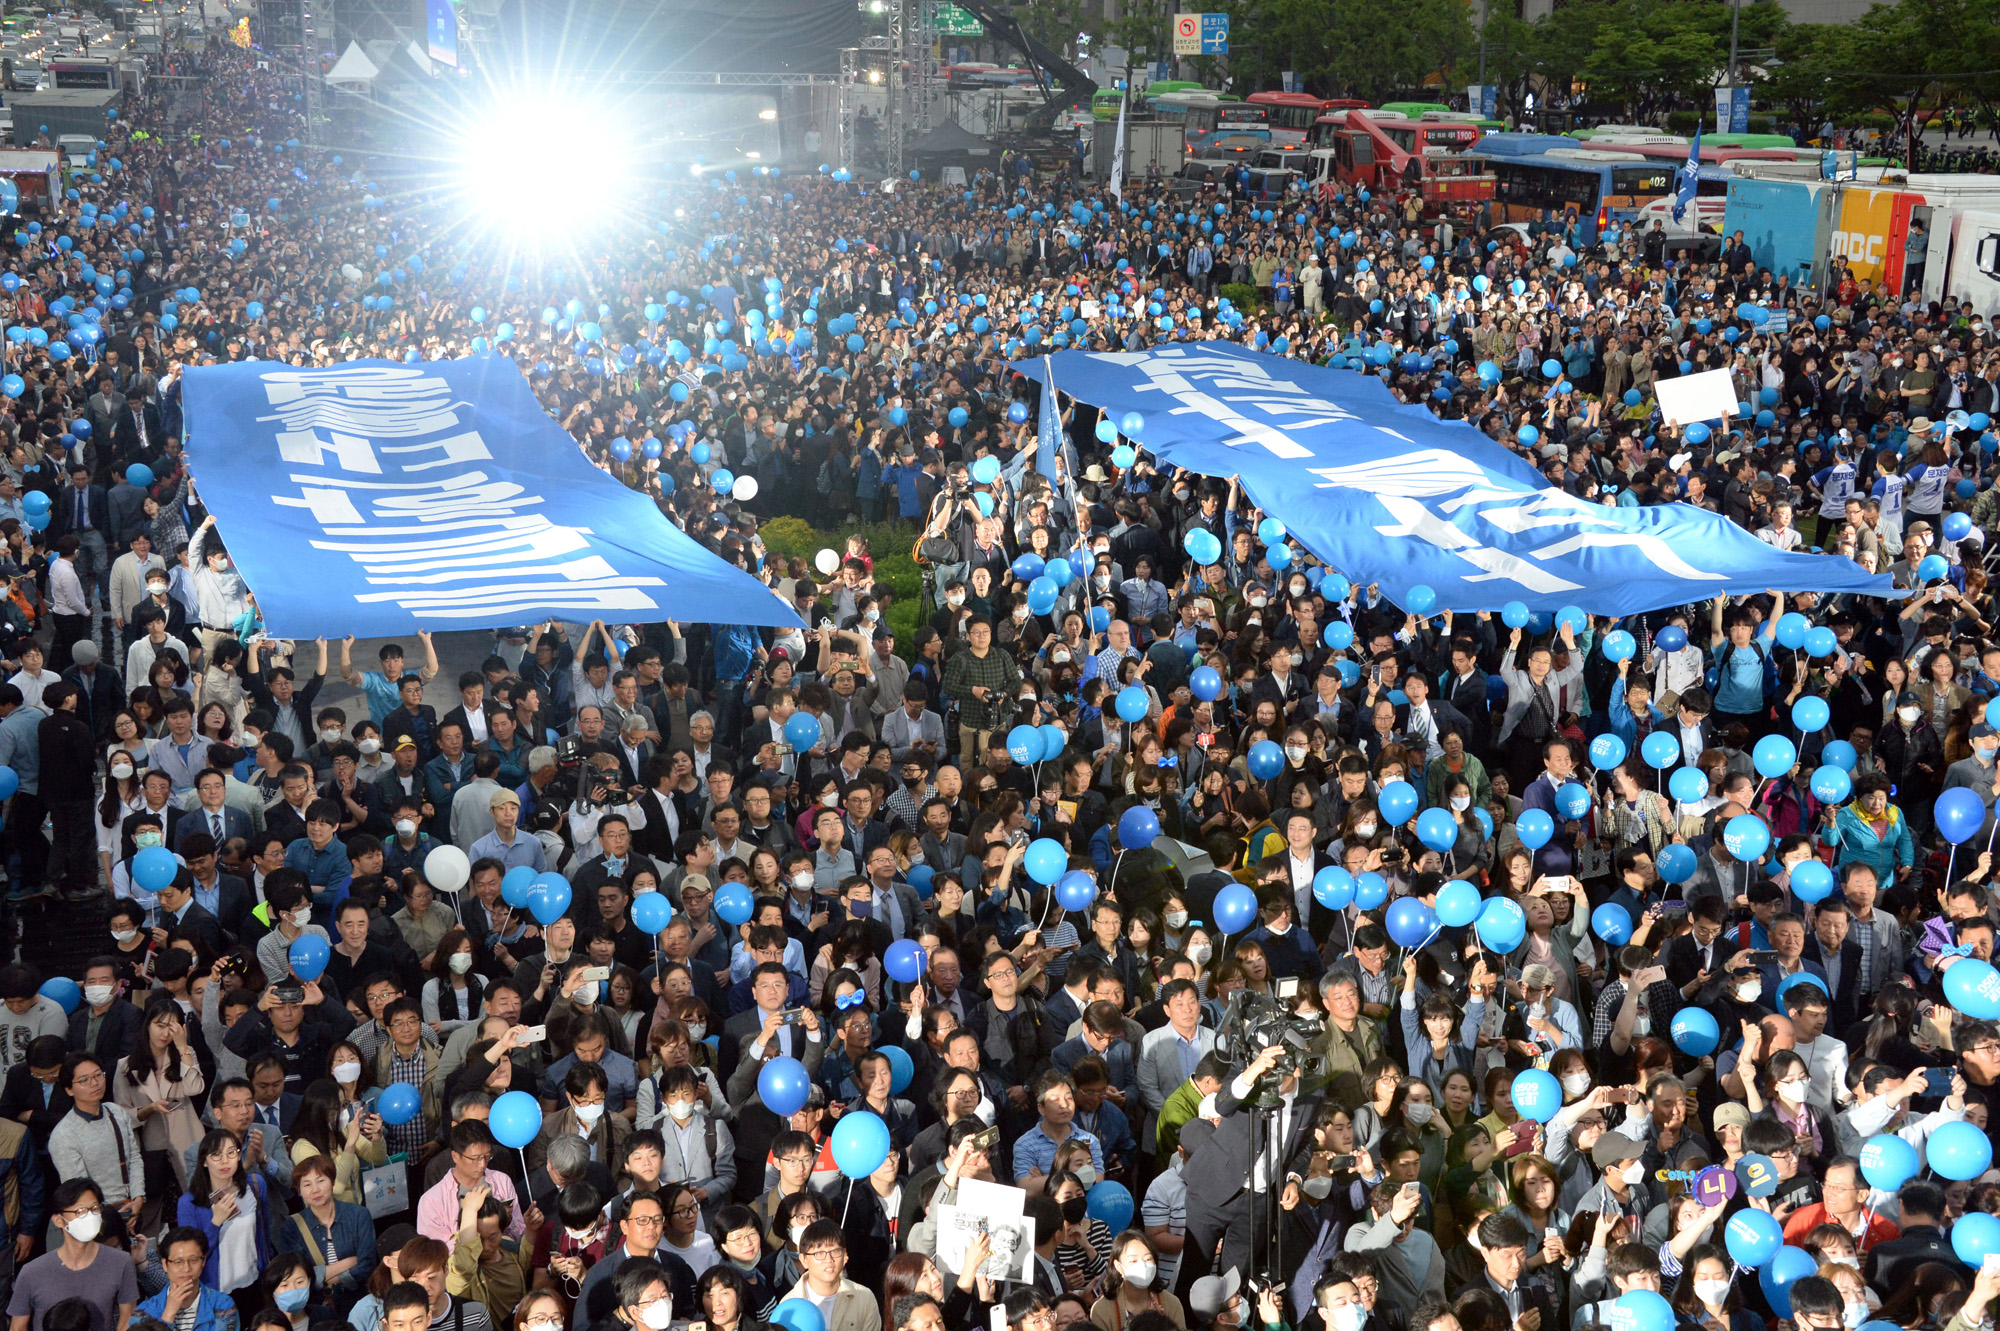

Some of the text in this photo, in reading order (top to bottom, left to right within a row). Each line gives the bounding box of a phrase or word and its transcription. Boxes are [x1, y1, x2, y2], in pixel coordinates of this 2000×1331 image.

[1456, 131, 1472, 140] 1900
[1649, 176, 1666, 188] 402
[1830, 230, 1883, 265] MBC
[1832, 471, 1855, 482] 문재인
[1927, 467, 1949, 479] 문재인
[1839, 482, 1847, 497] 1
[1887, 482, 1903, 494] 문재인
[1932, 478, 1942, 493] 1
[1893, 492, 1900, 509] 1
[271, 470, 668, 618] 든든한
[1594, 738, 1611, 748] 0509
[1010, 746, 1027, 755] 0509
[1662, 749, 1679, 764] 0509
[1817, 785, 1837, 795] 0509
[1568, 798, 1585, 808] 0509
[1724, 833, 1741, 844] 0509
[1978, 970, 1999, 992] 0509
[1514, 1082, 1539, 1093] 0509
[1517, 1095, 1537, 1106] 투표!
[1861, 1144, 1883, 1155] 0509
[1703, 1173, 1727, 1195] 니
